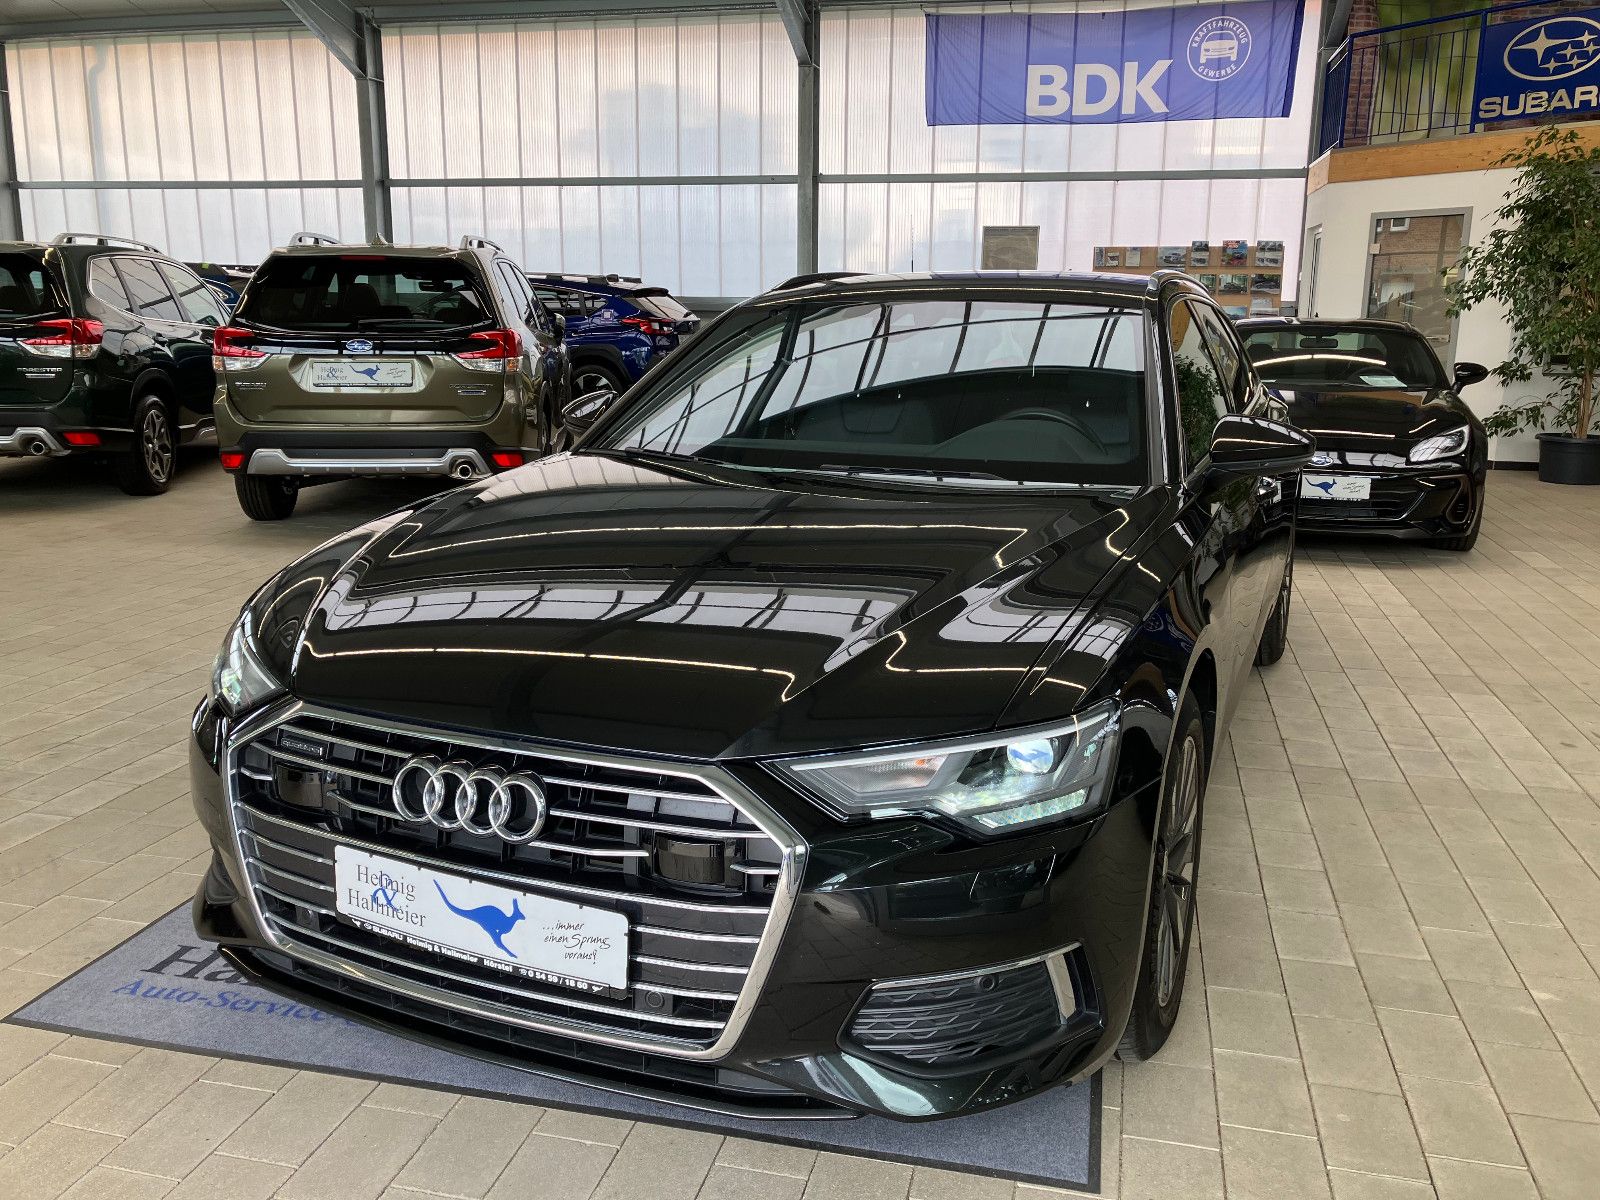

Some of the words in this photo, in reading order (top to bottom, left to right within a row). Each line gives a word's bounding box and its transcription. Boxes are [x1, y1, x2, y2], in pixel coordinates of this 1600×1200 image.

[1191, 20, 1248, 48] KRAFTFAHRZEUG
[1026, 59, 1173, 117] BDK
[1197, 63, 1237, 78] GEWERBE
[1478, 85, 1600, 118] SUBAR
[356, 864, 416, 902] Helmig
[347, 887, 426, 928] Hallmeier
[372, 925, 403, 941] SUBARU
[406, 936, 433, 952] Helmig
[433, 944, 441, 953] &
[441, 947, 479, 963] Hallmeier
[527, 970, 534, 978] 0
[535, 972, 546, 981] 54
[543, 931, 569, 943] einen
[564, 933, 611, 950] Sprung
[140, 944, 259, 987] Ha
